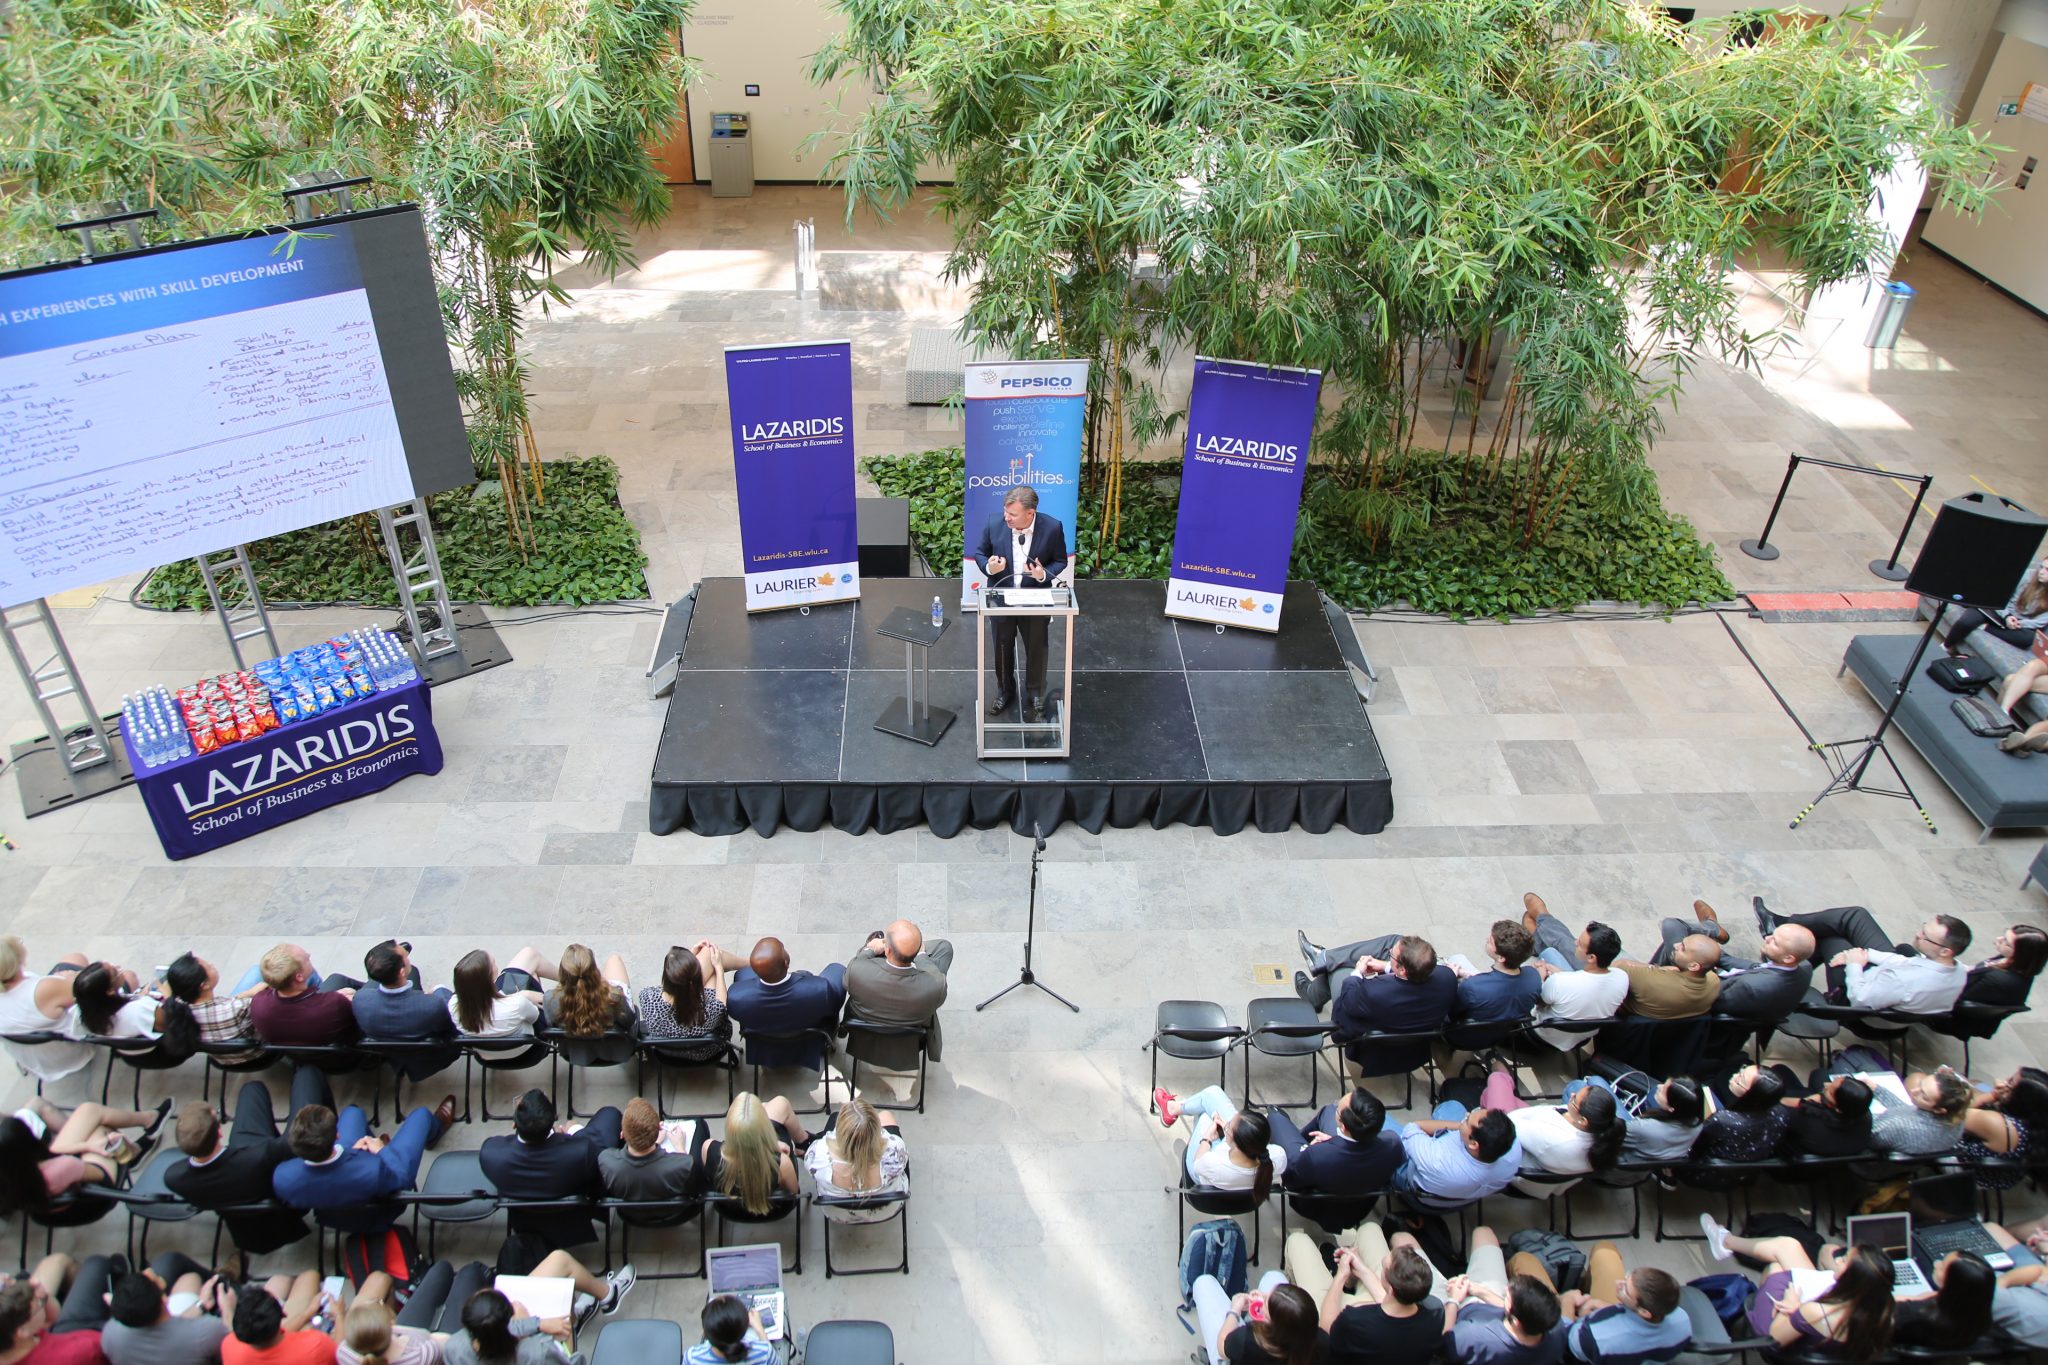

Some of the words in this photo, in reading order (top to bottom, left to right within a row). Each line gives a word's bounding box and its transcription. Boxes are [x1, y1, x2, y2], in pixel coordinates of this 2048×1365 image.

[11, 294, 117, 324] EXPERIENCES
[119, 285, 157, 304] WITH
[160, 279, 198, 296] SKILL
[201, 260, 305, 289] DEVELOPMENT
[72, 342, 140, 362] Career
[145, 331, 194, 348] Plan
[1001, 377, 1073, 388] PEPSICO
[993, 406, 1016, 416] push
[1017, 404, 1056, 414] serve
[742, 416, 844, 441] LAZARIDIS
[993, 423, 1030, 431] challenge
[1019, 429, 1058, 437] innovate
[744, 444, 766, 453] School
[766, 443, 774, 452] of
[775, 441, 801, 449] Business
[809, 437, 843, 447] Economics
[1016, 444, 1042, 453] apply
[1195, 433, 1298, 462] LAZARIDIS
[1194, 453, 1216, 464] School
[1225, 458, 1251, 468] Business
[1259, 463, 1293, 474] Economics
[969, 466, 1063, 489] possibilities
[1, 511, 46, 529] Build
[168, 460, 233, 484] developed
[239, 453, 265, 465] and
[62, 507, 93, 521] and
[753, 548, 829, 562] Lazaridis-SBE.wlu.ca
[1181, 562, 1256, 579] Lazaridis-SBE.wlu.ca
[755, 577, 817, 594] LAURIER
[1177, 590, 1238, 609] LAURIER
[173, 704, 415, 814] LAZARIDIS
[192, 806, 243, 836] School
[247, 799, 264, 817] of
[265, 779, 327, 809] Business
[331, 772, 343, 786] &
[347, 746, 419, 781] Economics
